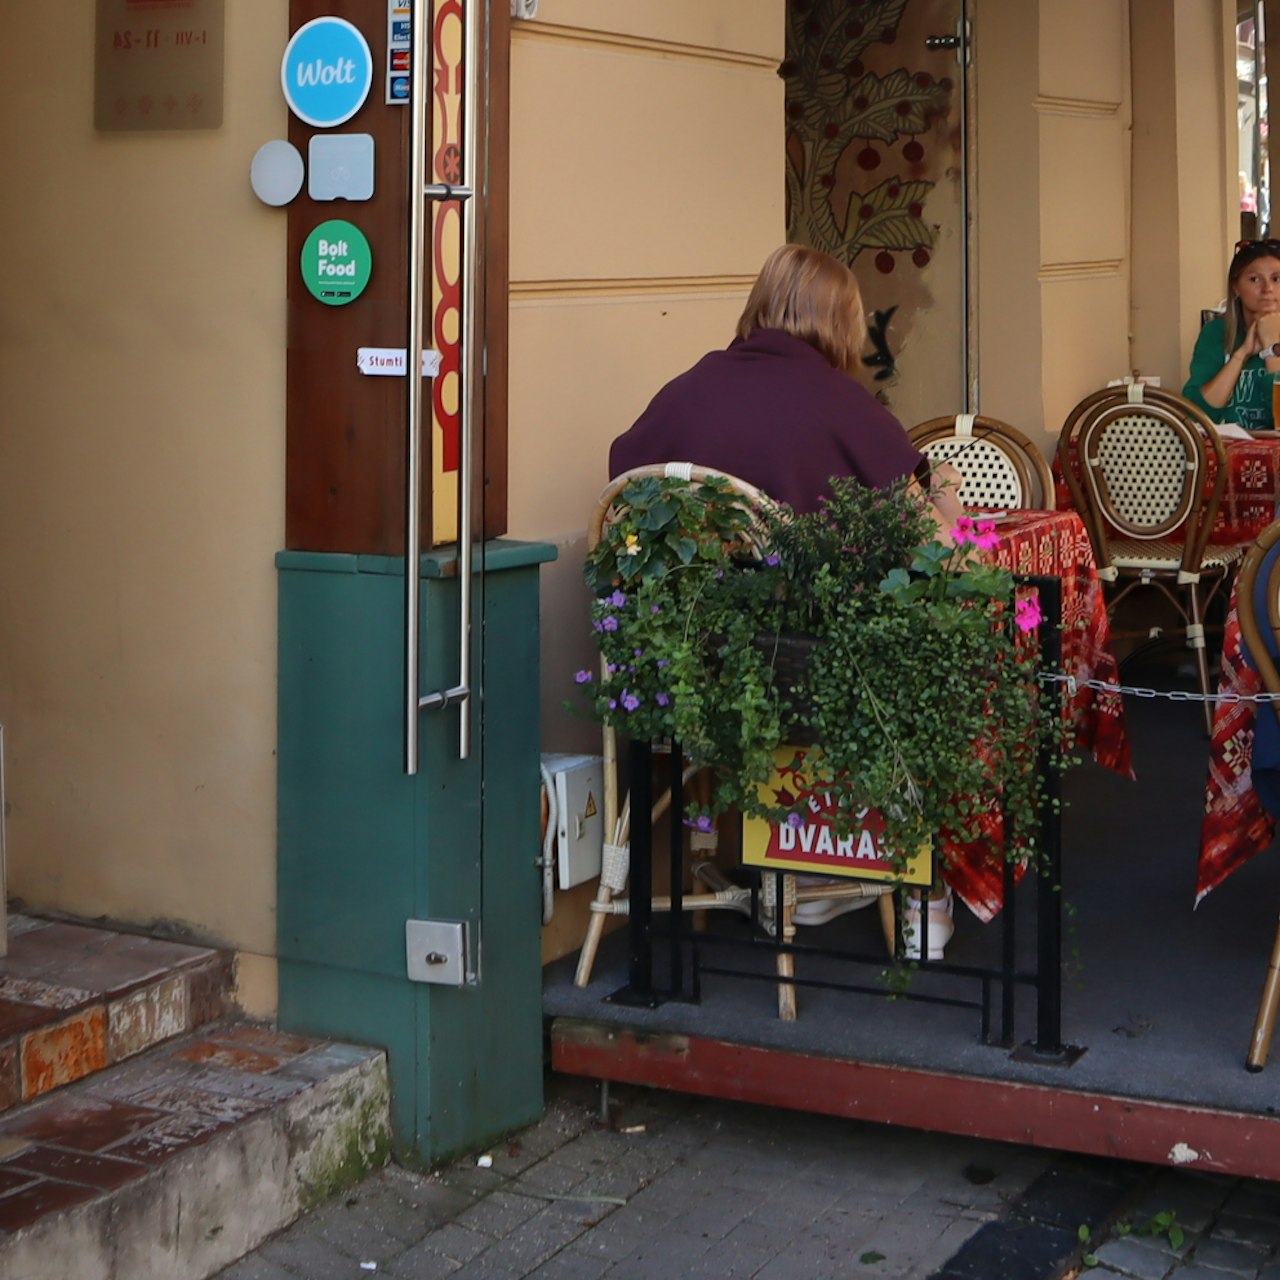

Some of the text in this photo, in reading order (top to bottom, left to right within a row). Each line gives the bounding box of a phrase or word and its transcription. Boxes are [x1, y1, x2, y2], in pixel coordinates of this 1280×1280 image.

[297, 57, 356, 88] Wolt
[318, 239, 348, 261] Bolt
[318, 259, 355, 276] Food
[369, 355, 403, 367] Stumti
